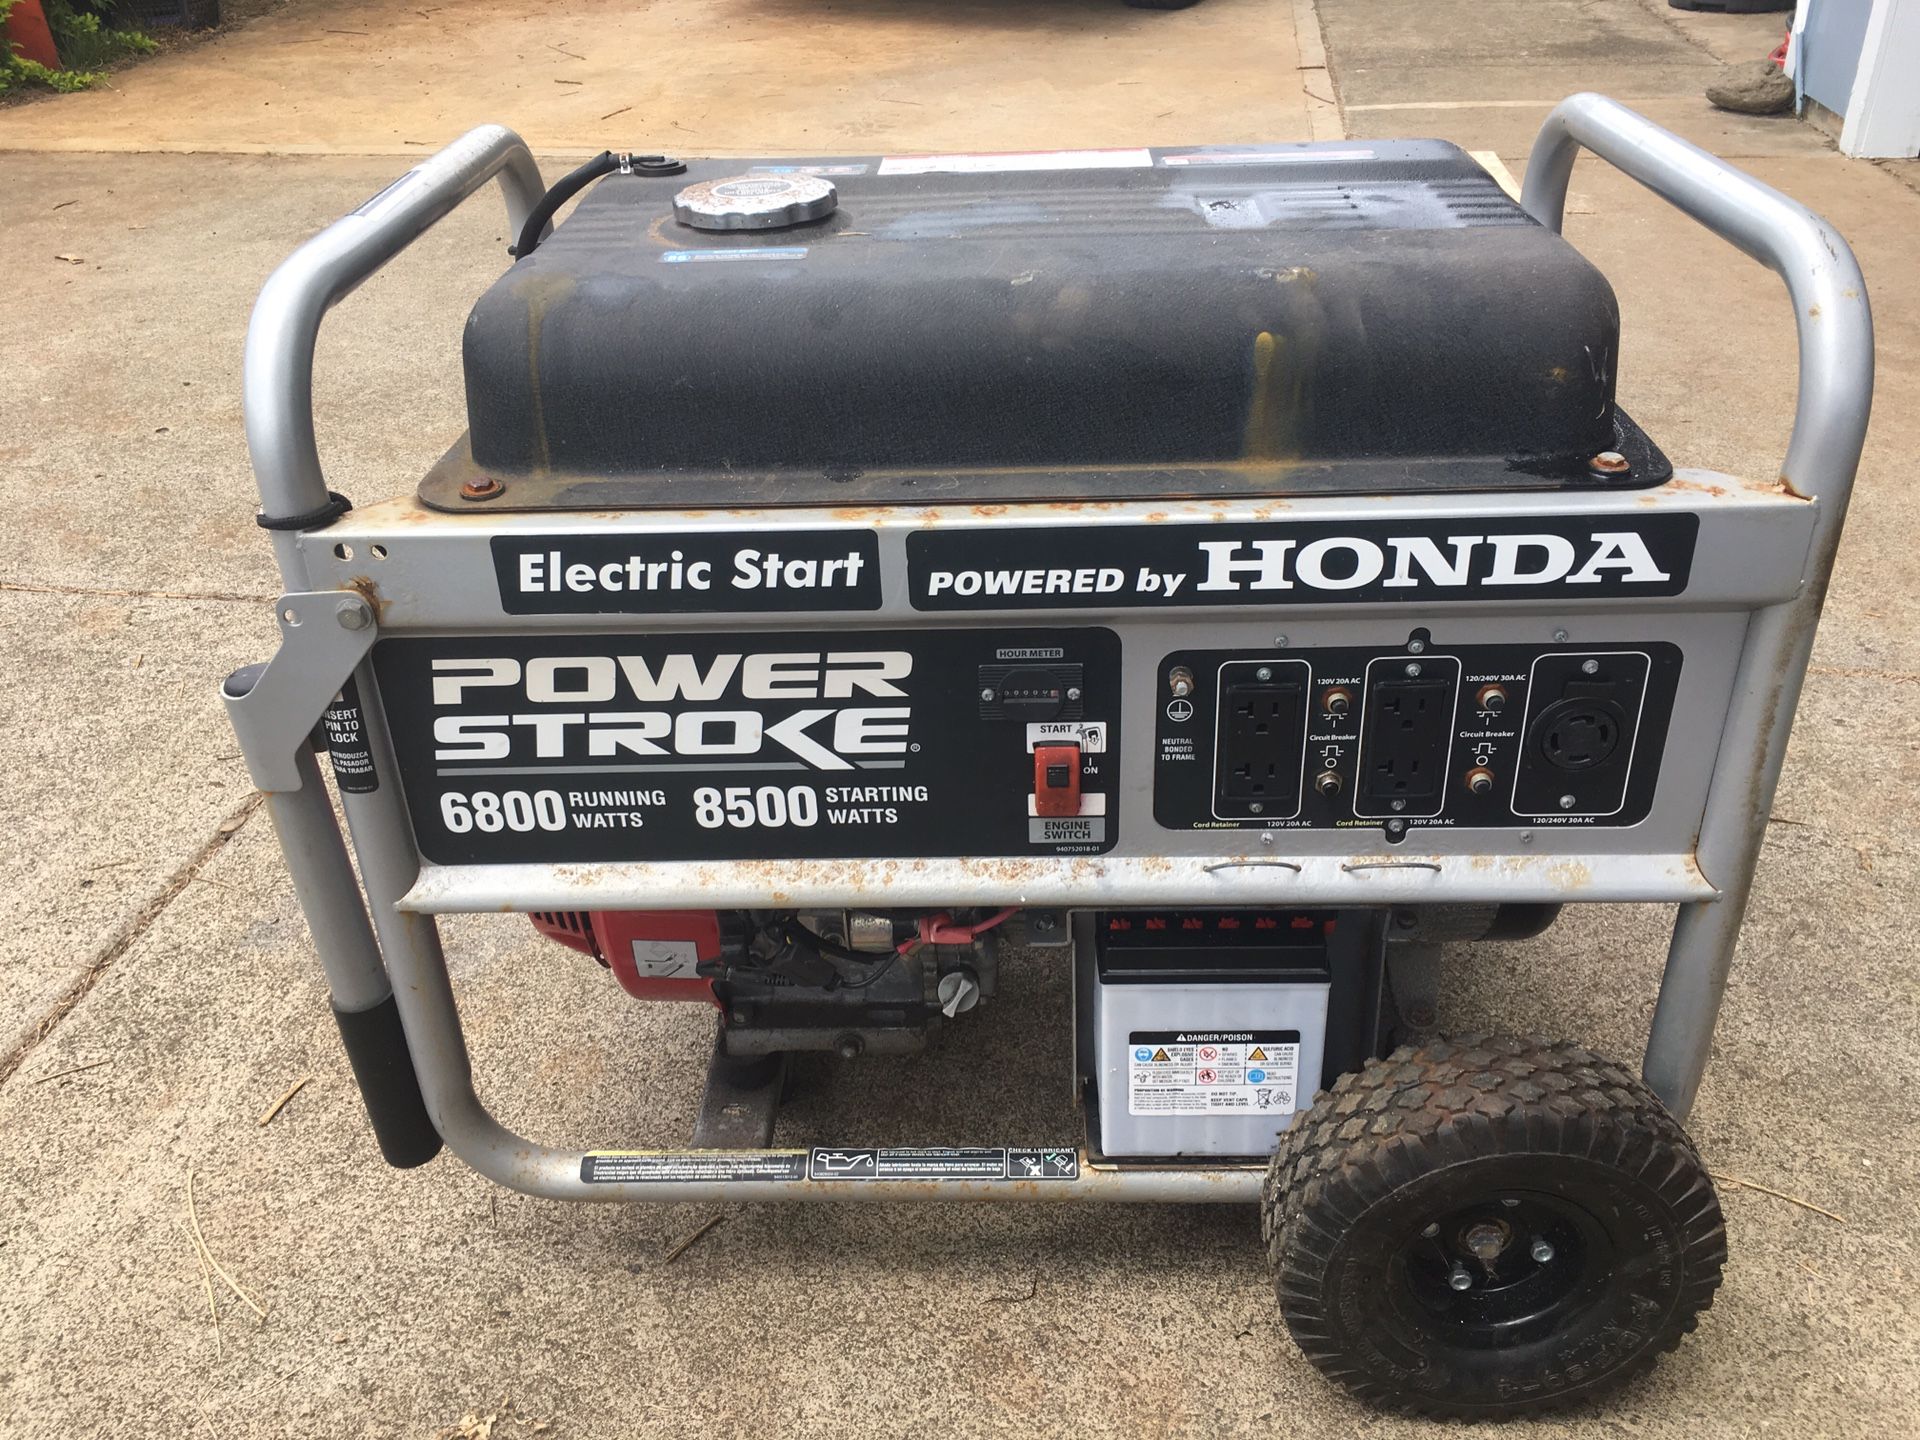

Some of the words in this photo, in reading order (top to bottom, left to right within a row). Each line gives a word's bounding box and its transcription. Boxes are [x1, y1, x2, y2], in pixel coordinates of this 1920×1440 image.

[928, 568, 1124, 596] POWERED
[1136, 568, 1186, 597] by
[1197, 532, 1670, 592] HONDA
[519, 550, 711, 592] Electric
[731, 549, 864, 590] Start
[999, 649, 1027, 658] HOUR
[1030, 649, 1061, 657] METER
[431, 651, 913, 704] POWER
[325, 720, 341, 731] PIN
[343, 720, 359, 731] TO
[1040, 725, 1072, 733] START
[330, 732, 358, 743] LOCK
[433, 707, 913, 770] STROKE
[1083, 766, 1098, 774] ON
[440, 789, 567, 833] 6800
[569, 790, 666, 807] RUNNING
[693, 785, 818, 828] 8500
[826, 785, 928, 803] STARTING
[572, 811, 643, 829] WATTS
[828, 807, 898, 825] WATTS
[1044, 821, 1090, 830] ENGINE
[1044, 831, 1091, 839] SWITCH
[1186, 1034, 1253, 1042] DANGER/POISON
